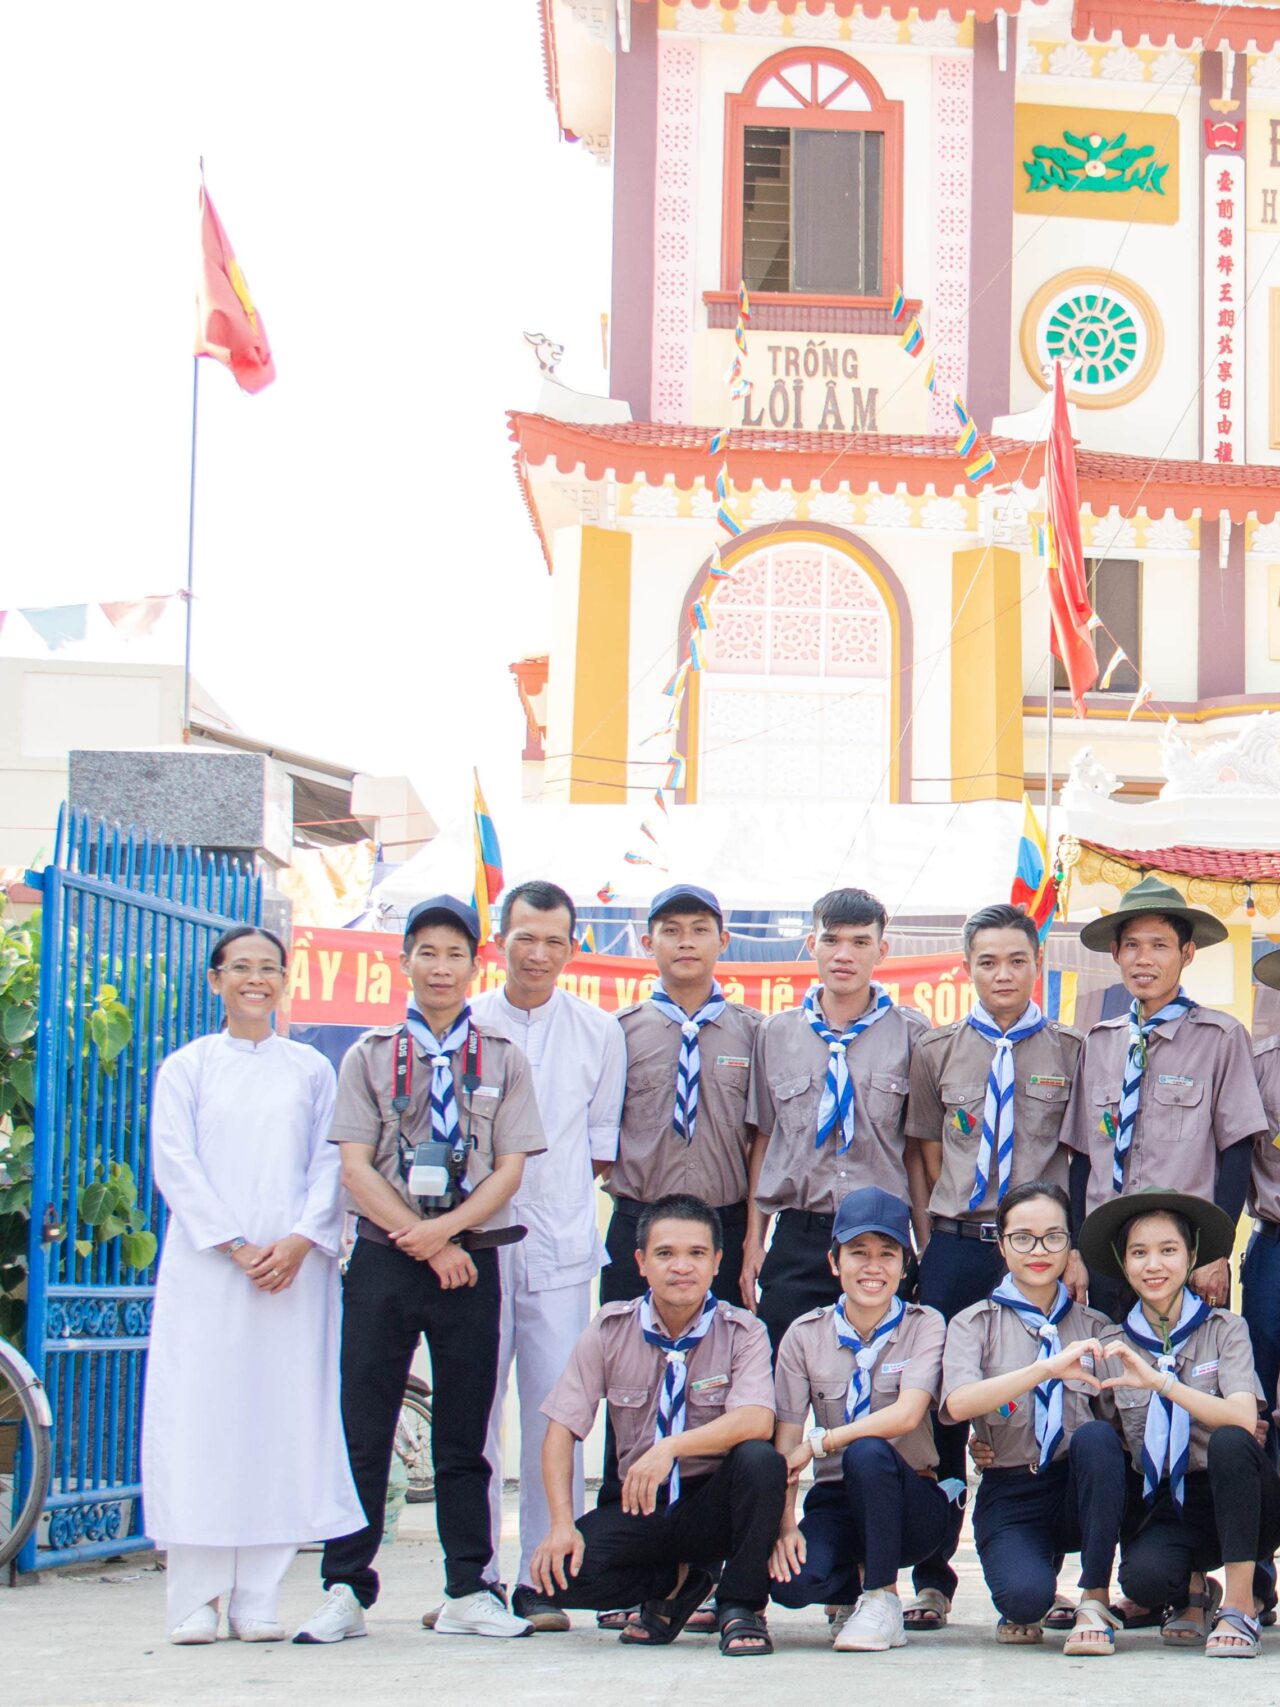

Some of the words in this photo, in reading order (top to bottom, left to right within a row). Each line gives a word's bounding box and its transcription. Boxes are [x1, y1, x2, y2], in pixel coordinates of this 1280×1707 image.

[767, 339, 859, 379] TRỐNG
[818, 380, 879, 432] ÂM
[290, 931, 344, 1002] ẦY
[355, 950, 392, 1005] là
